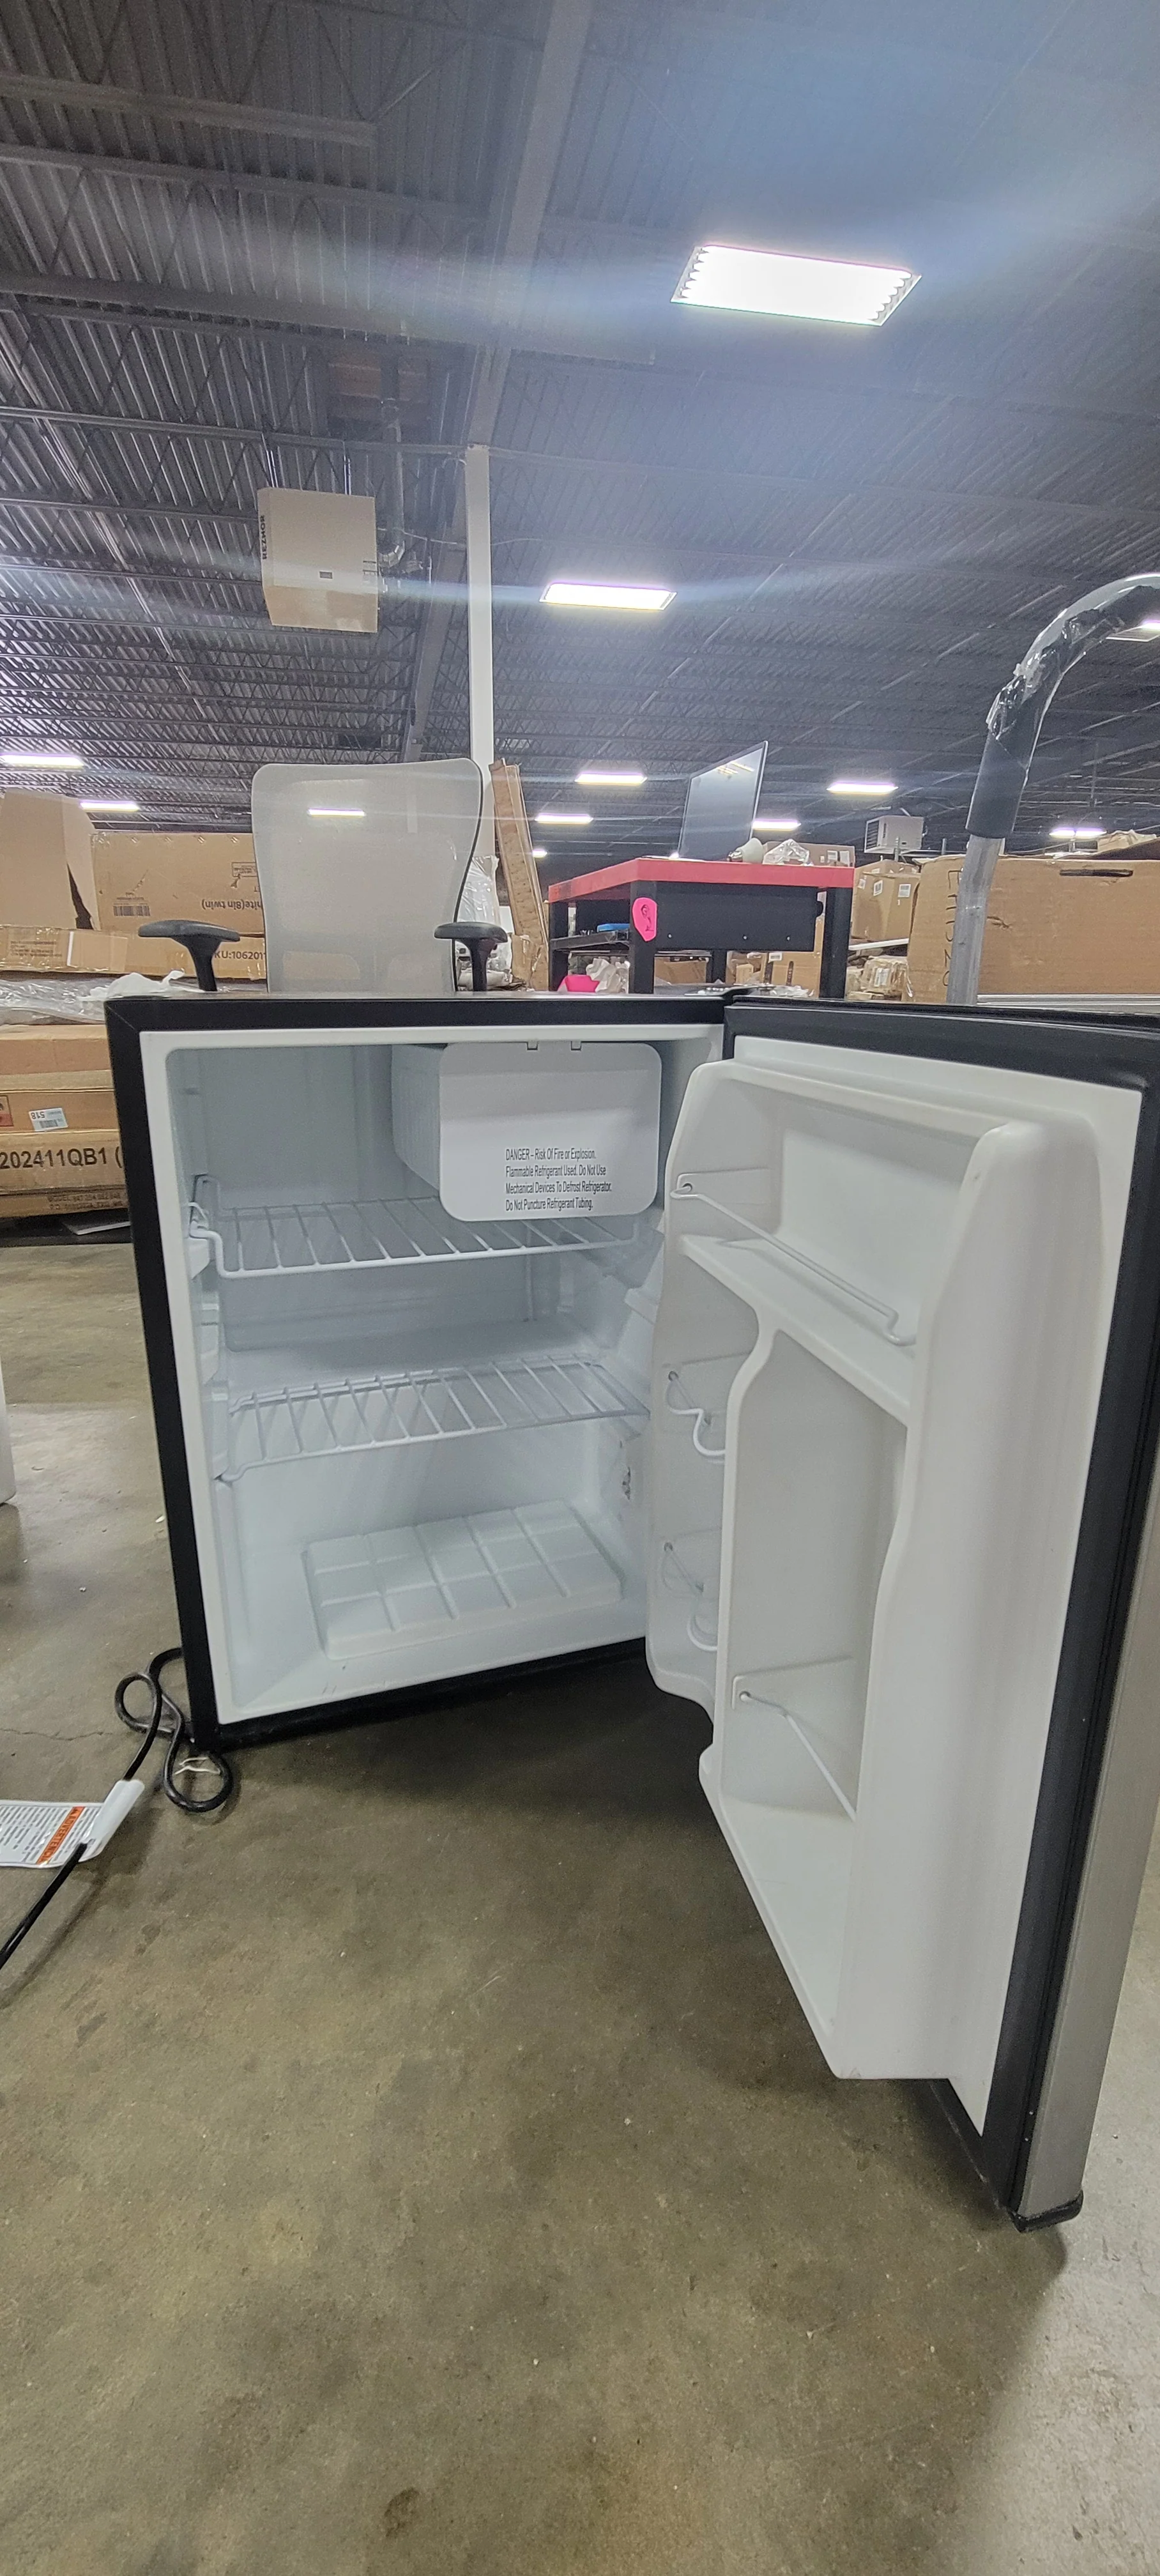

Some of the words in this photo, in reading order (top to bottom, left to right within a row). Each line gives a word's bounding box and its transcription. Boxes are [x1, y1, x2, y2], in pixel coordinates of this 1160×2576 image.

[201, 899, 225, 910] twin)
[227, 898, 262, 910] hite(8in
[214, 951, 266, 960] KU:106201
[31, 1111, 46, 1120] 518
[506, 1148, 530, 1160] DANGER
[535, 1148, 546, 1160] Risk
[547, 1147, 554, 1160] Of
[554, 1147, 564, 1160] Fire
[565, 1150, 570, 1160] or
[571, 1147, 597, 1162] Explosion.
[506, 1165, 534, 1177] Flammable
[535, 1165, 563, 1179] Refrigerant
[563, 1164, 578, 1176] Used.
[579, 1164, 586, 1176] Do
[586, 1164, 596, 1176] Not
[596, 1164, 606, 1176] Use
[506, 1182, 535, 1194] Mechanical
[535, 1181, 555, 1193] Devices
[556, 1181, 562, 1193] To
[563, 1181, 581, 1193] Defrost
[582, 1180, 612, 1195] Refrigerator.
[506, 1199, 514, 1211] Do
[514, 1199, 523, 1211] Not
[524, 1198, 546, 1210] Puncture
[547, 1197, 575, 1212] Refrigerant
[576, 1197, 593, 1211] Tubing.
